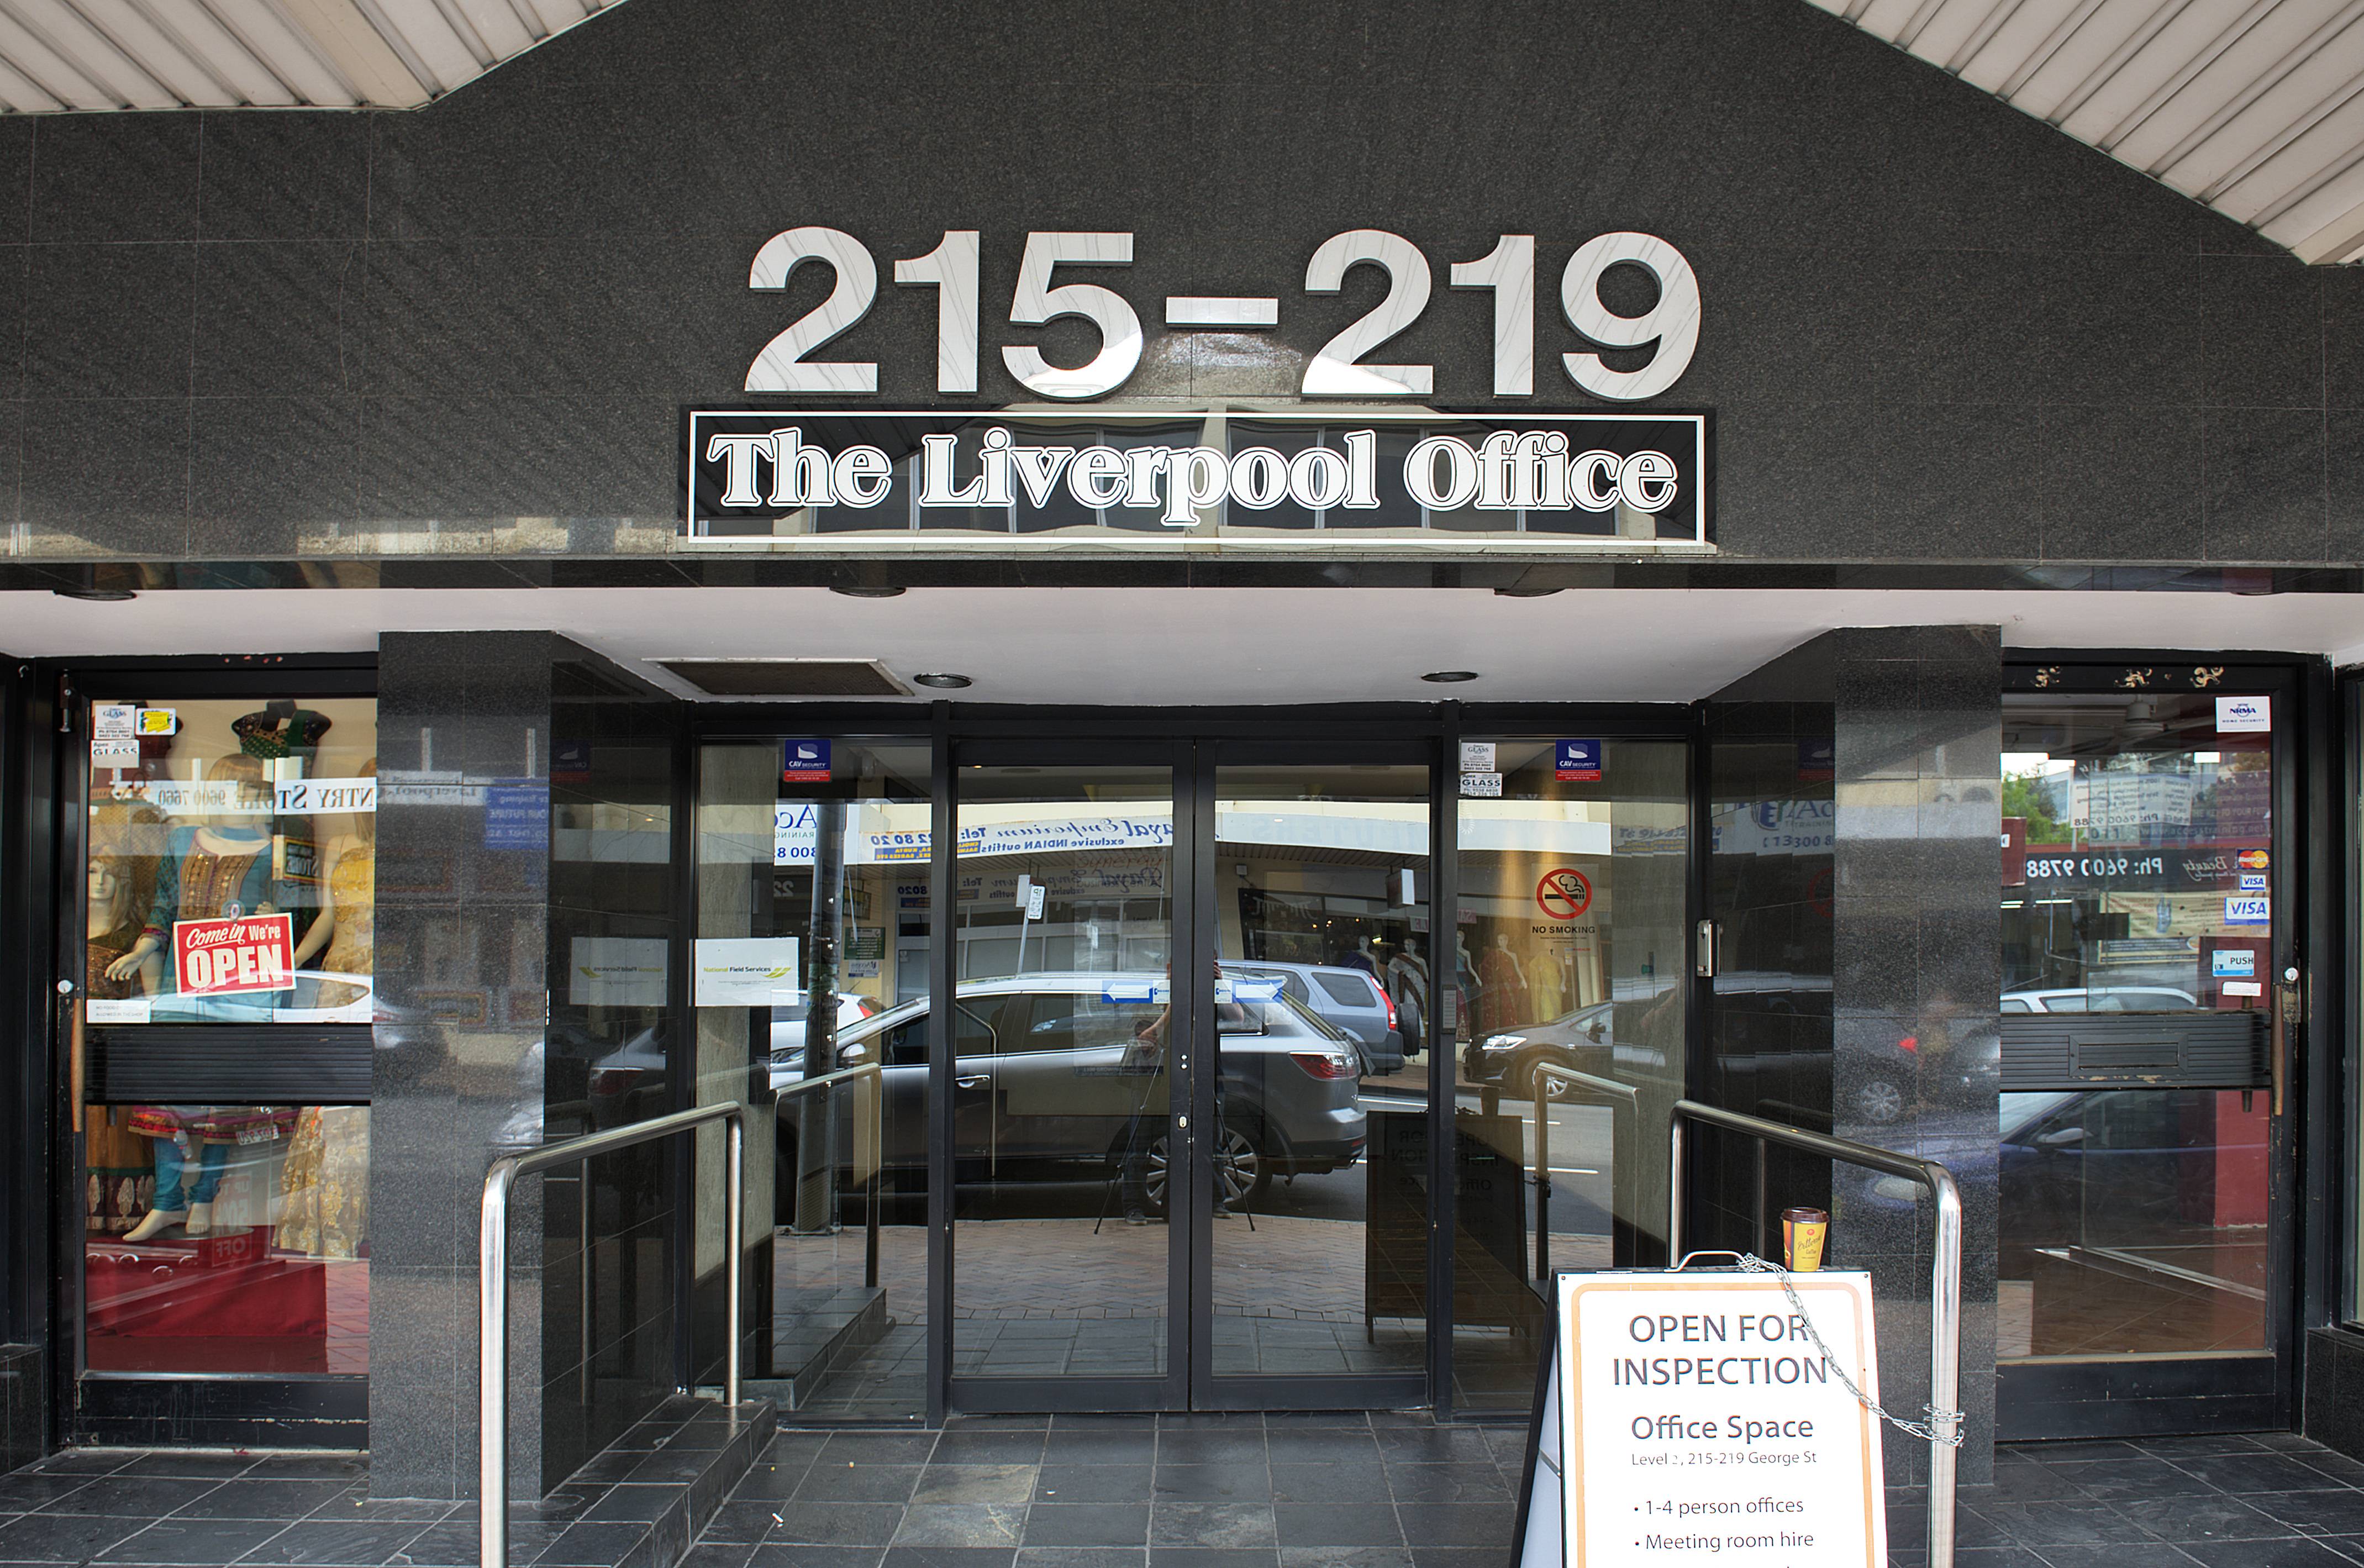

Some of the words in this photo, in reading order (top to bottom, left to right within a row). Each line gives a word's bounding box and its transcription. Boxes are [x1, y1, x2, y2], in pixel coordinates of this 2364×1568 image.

[744, 225, 1702, 403] 215-219
[706, 426, 893, 508] The
[918, 426, 1381, 527] Liverpool
[1403, 430, 1678, 513] Office
[2243, 877, 2264, 885] VISA
[2230, 901, 2267, 915] VISA
[186, 925, 229, 949] Come
[228, 923, 246, 942] in
[248, 924, 281, 941] We're
[1549, 925, 1596, 934] SMOKING
[186, 944, 284, 988] OPEN
[2230, 956, 2254, 965] PUSH
[1629, 1314, 1726, 1343] OPEN
[1739, 1314, 1809, 1341] FOR
[1613, 1356, 1828, 1386] INSPECTION
[1631, 1414, 1718, 1440] Office
[1728, 1414, 1814, 1445] Space
[1631, 1453, 1668, 1466] Level
[1688, 1452, 1745, 1465] 215-219
[1748, 1451, 1800, 1466] George
[1803, 1450, 1818, 1464] St
[1646, 1499, 1674, 1515] 1-4
[1678, 1501, 1740, 1518] person
[1746, 1497, 1804, 1514] offices
[1646, 1533, 1721, 1553] Meeting
[1726, 1536, 1775, 1548] room
[1781, 1531, 1814, 1546] hire
